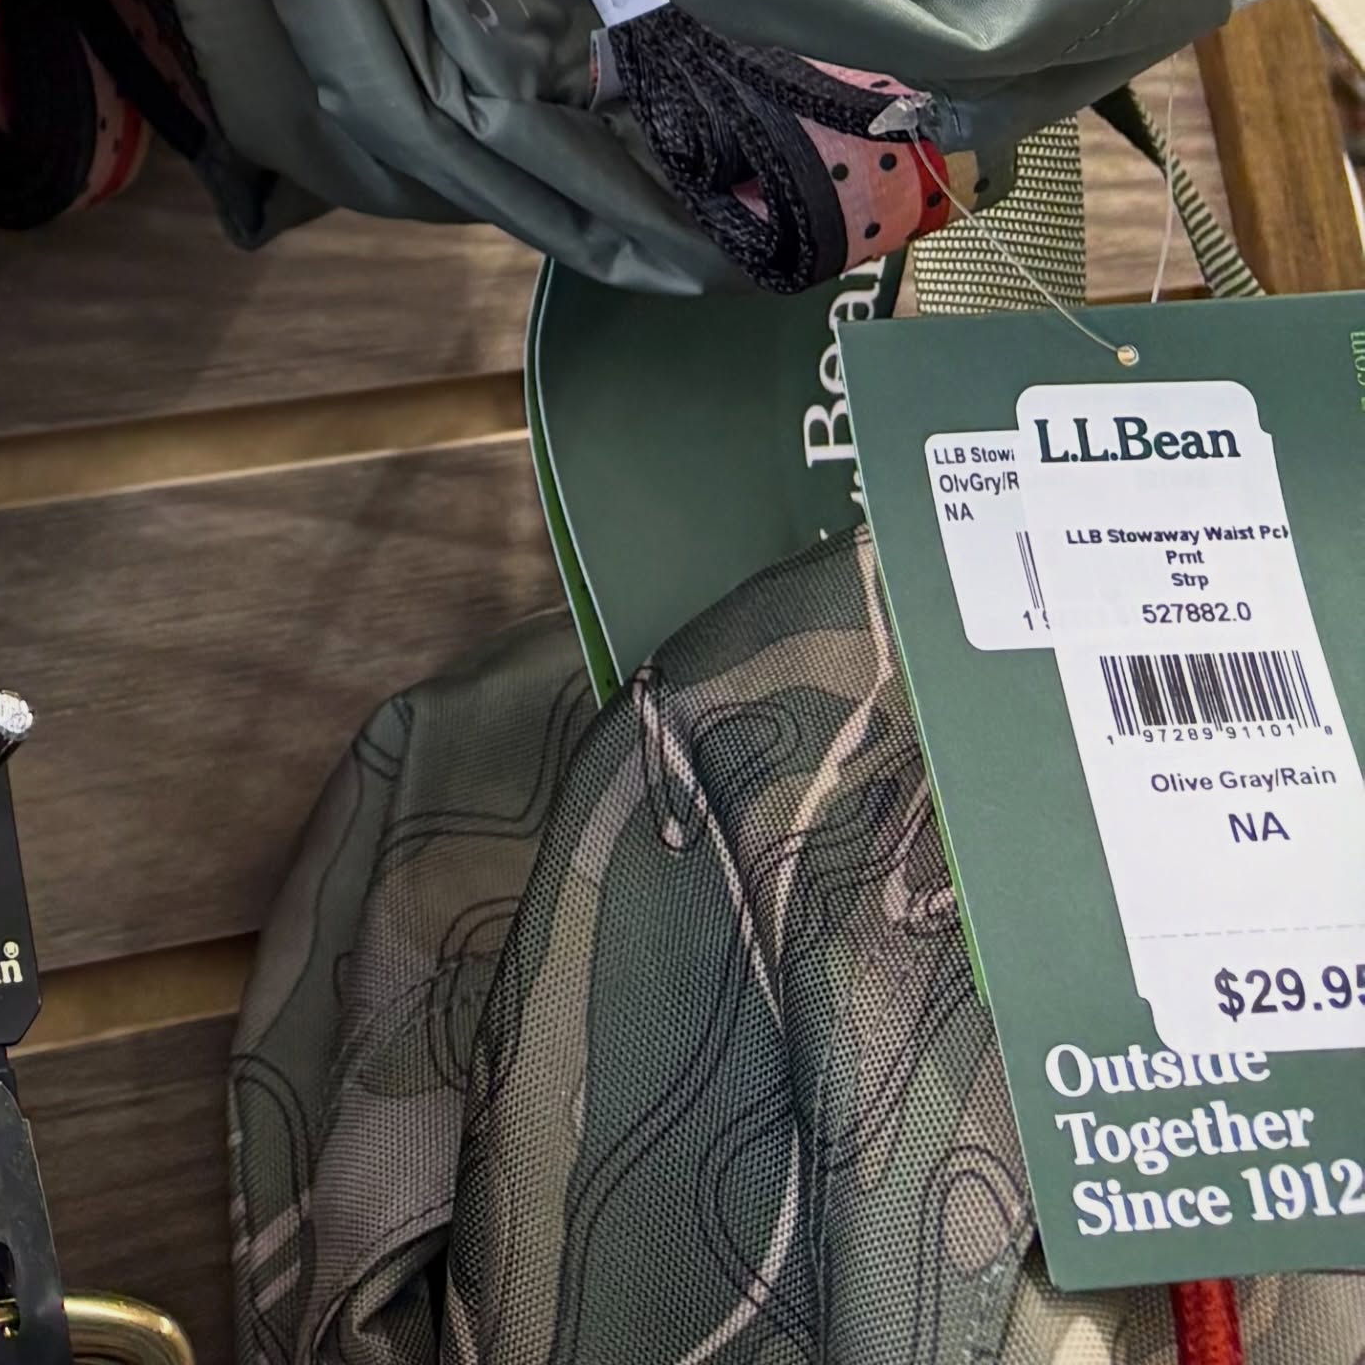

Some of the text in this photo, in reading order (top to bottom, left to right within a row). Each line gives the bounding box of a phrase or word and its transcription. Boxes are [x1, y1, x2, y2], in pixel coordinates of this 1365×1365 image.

[1034, 417, 1241, 462] L.L.Bean
[934, 448, 966, 464] LLB
[939, 471, 1019, 495] OlvGry/R
[944, 502, 974, 521] NA
[1066, 529, 1102, 544] LLB
[1107, 528, 1199, 545] Stowaway
[1204, 526, 1255, 540] Waist
[1171, 572, 1209, 591] Strp
[1142, 602, 1251, 623] 527882.0
[1151, 767, 1337, 792] Olive Gray/Rain
[1228, 812, 1290, 843] NA
[1054, 1100, 1314, 1175] Together
[1072, 1159, 1365, 1235] Since 1912
